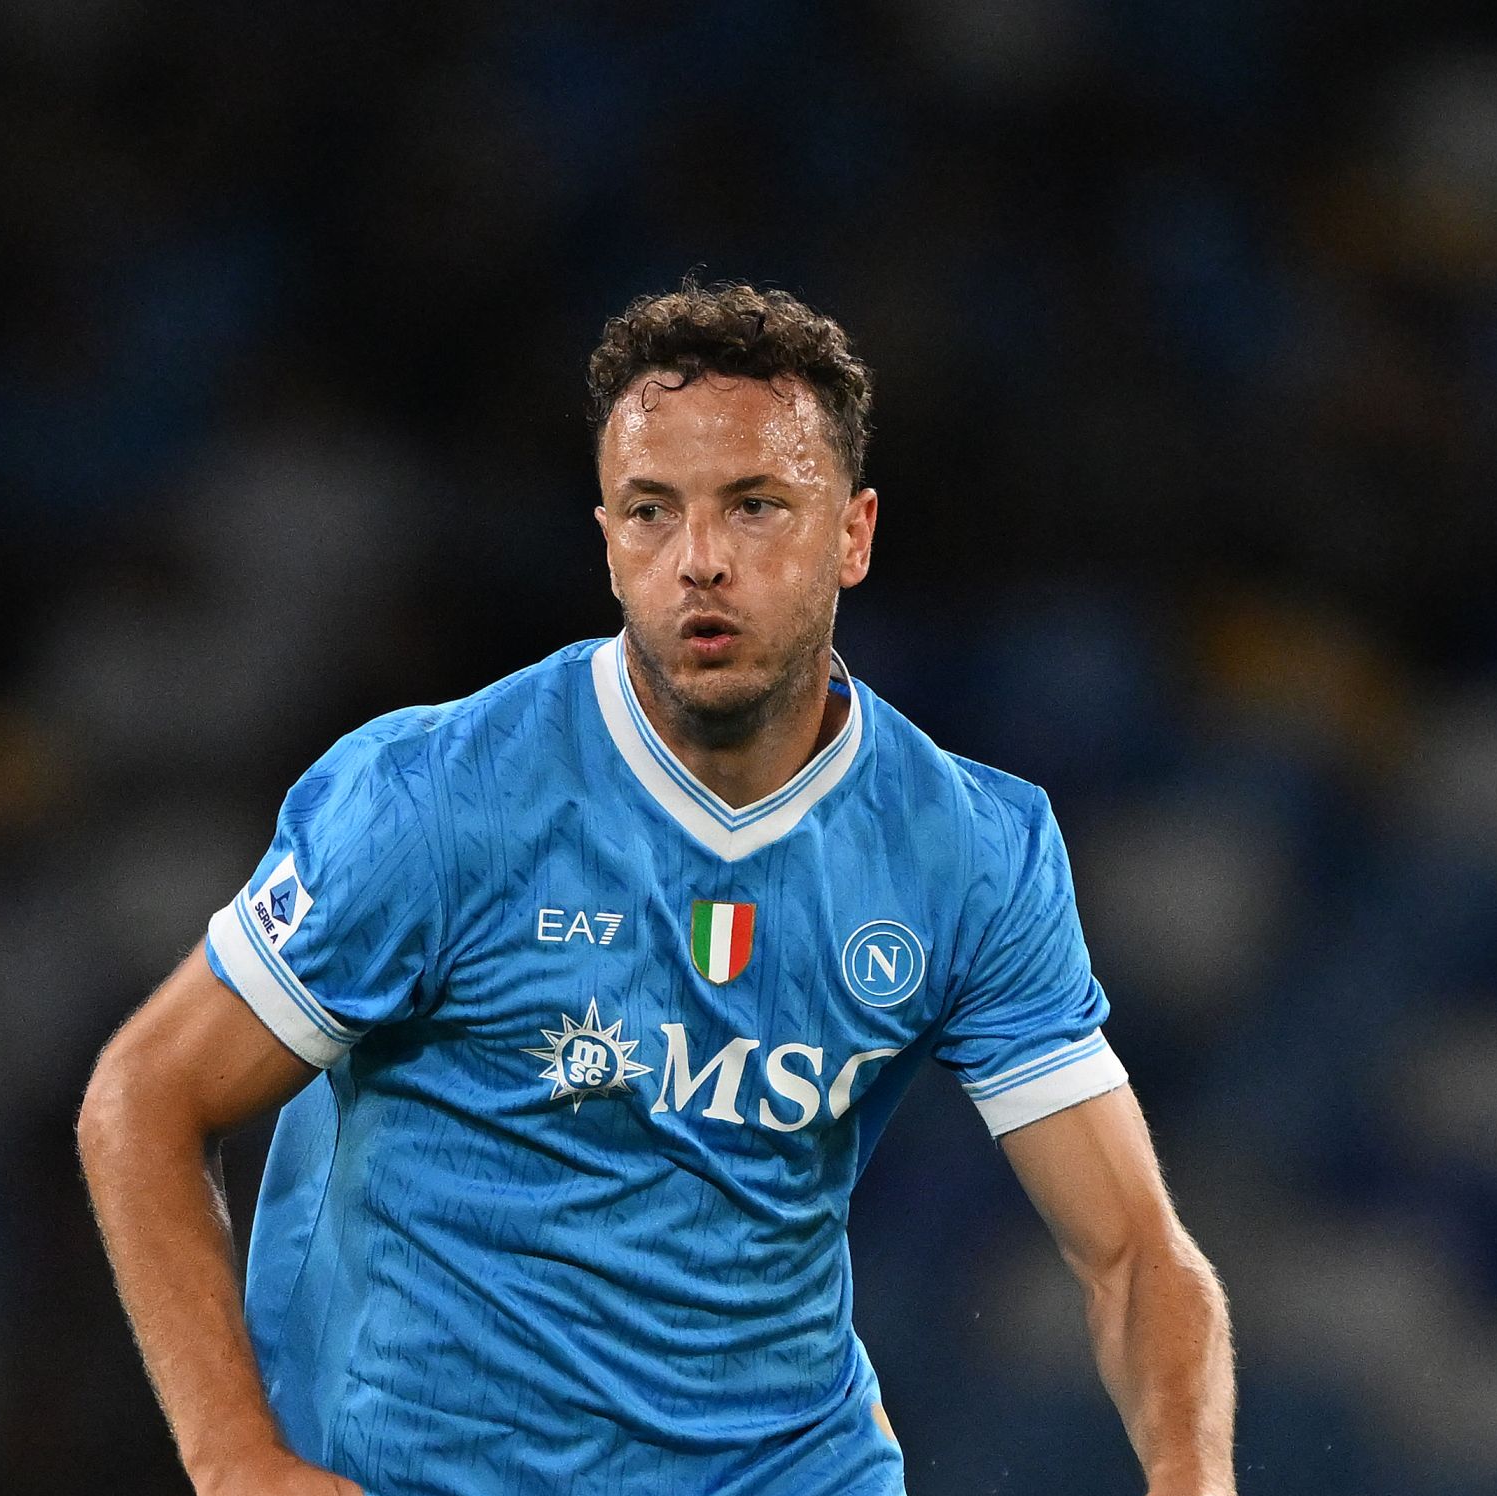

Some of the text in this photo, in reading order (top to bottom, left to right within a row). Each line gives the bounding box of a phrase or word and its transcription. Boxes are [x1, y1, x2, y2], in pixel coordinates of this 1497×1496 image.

[254, 901, 279, 945] SERIE A
[537, 908, 624, 945] EA7
[863, 944, 902, 984] N
